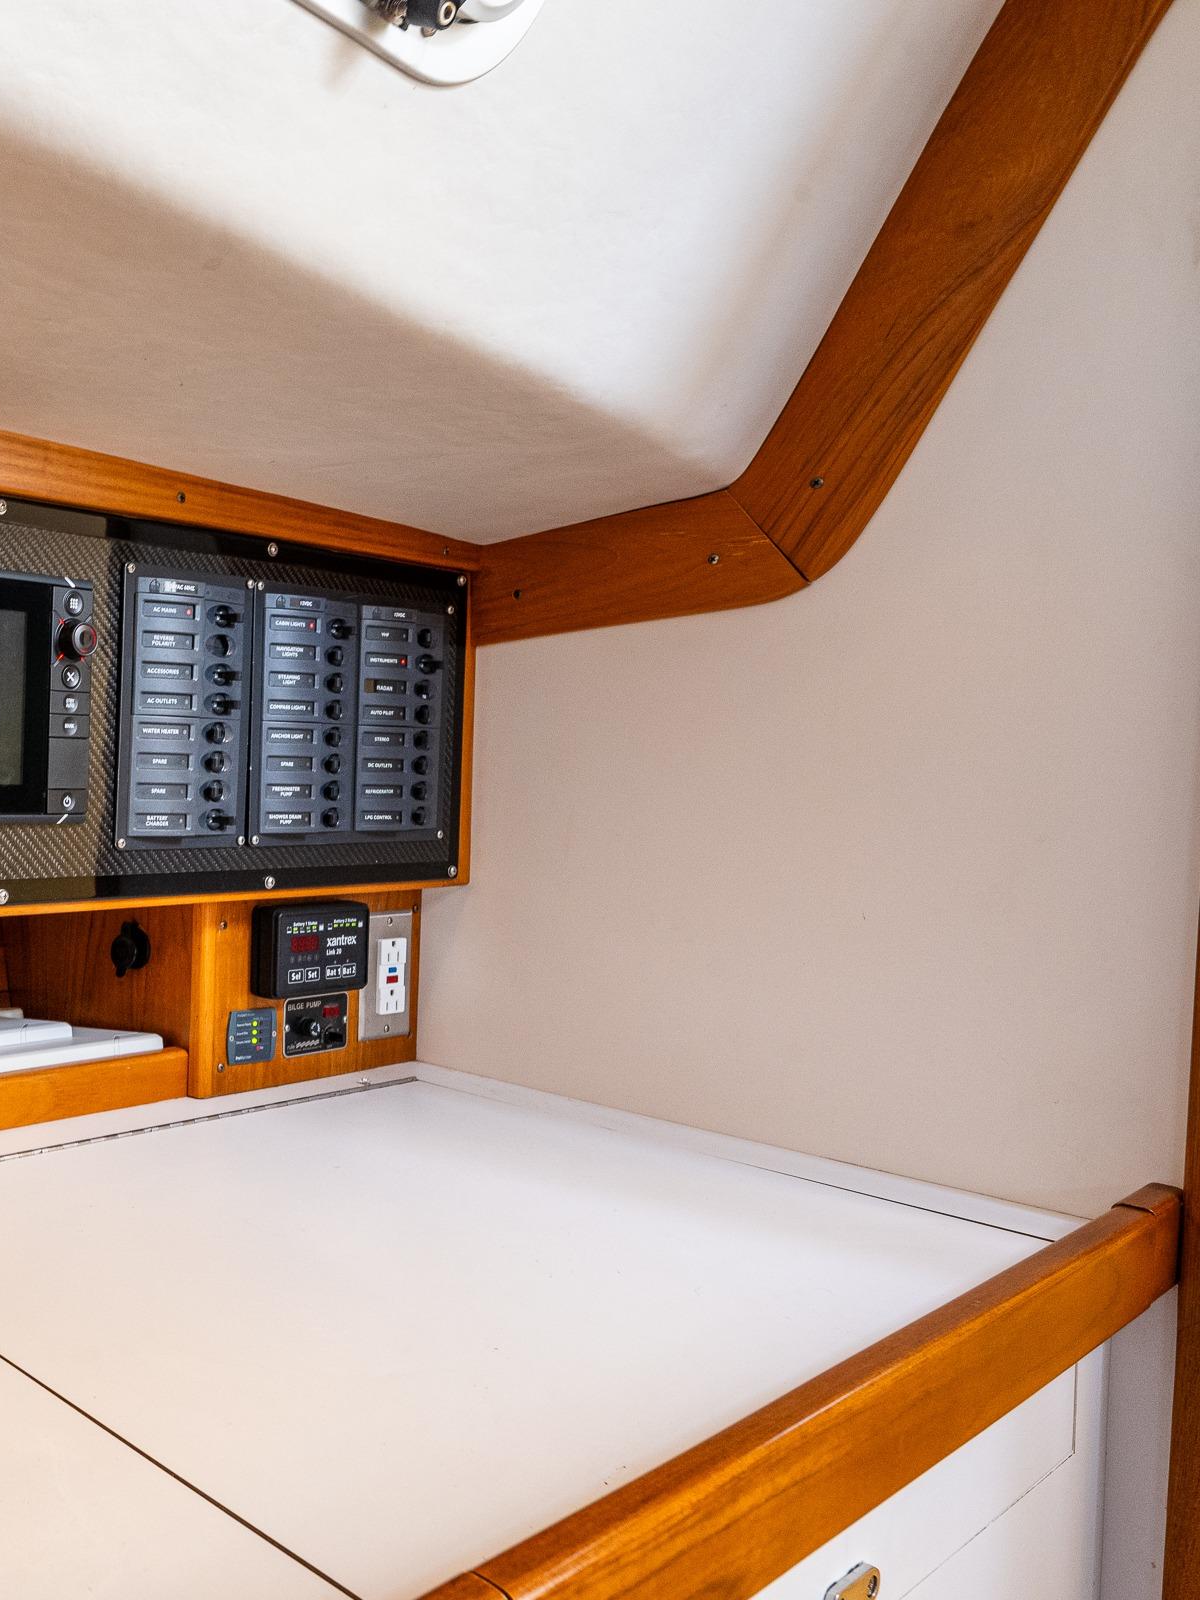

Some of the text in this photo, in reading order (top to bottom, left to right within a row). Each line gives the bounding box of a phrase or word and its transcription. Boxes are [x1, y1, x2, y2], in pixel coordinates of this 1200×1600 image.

[327, 934, 357, 948] xantrex
[326, 948, 335, 956] Link
[308, 970, 317, 979] Set
[327, 968, 336, 976] Bat
[343, 966, 352, 974] Bat
[291, 972, 301, 981] Sel
[288, 1003, 304, 1011] BILGE
[306, 1001, 321, 1009] PUMP
